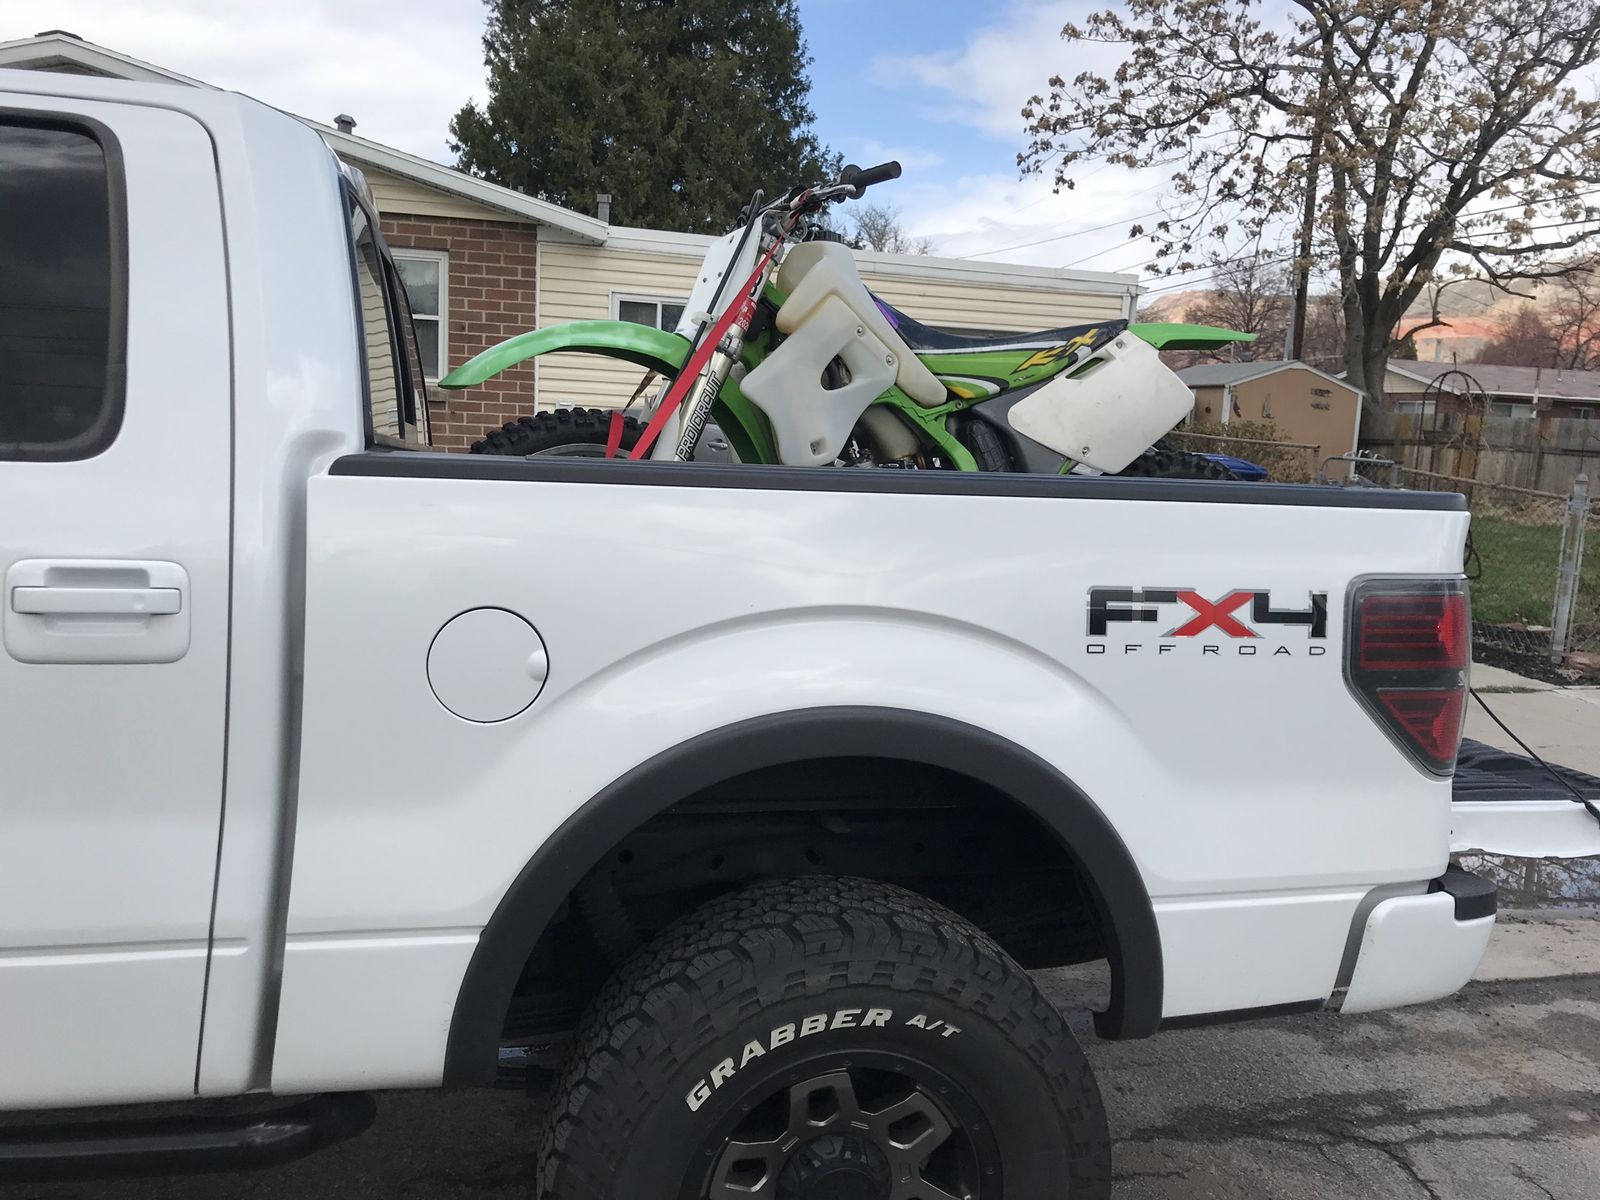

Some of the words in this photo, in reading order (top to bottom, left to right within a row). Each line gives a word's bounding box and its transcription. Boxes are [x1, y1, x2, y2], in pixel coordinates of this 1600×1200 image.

[675, 424, 699, 462] PRO
[690, 370, 722, 430] CIRCUIT
[1086, 585, 1329, 639] FX4
[684, 1008, 894, 1112] GRABBER
[905, 1013, 962, 1038] A/T
